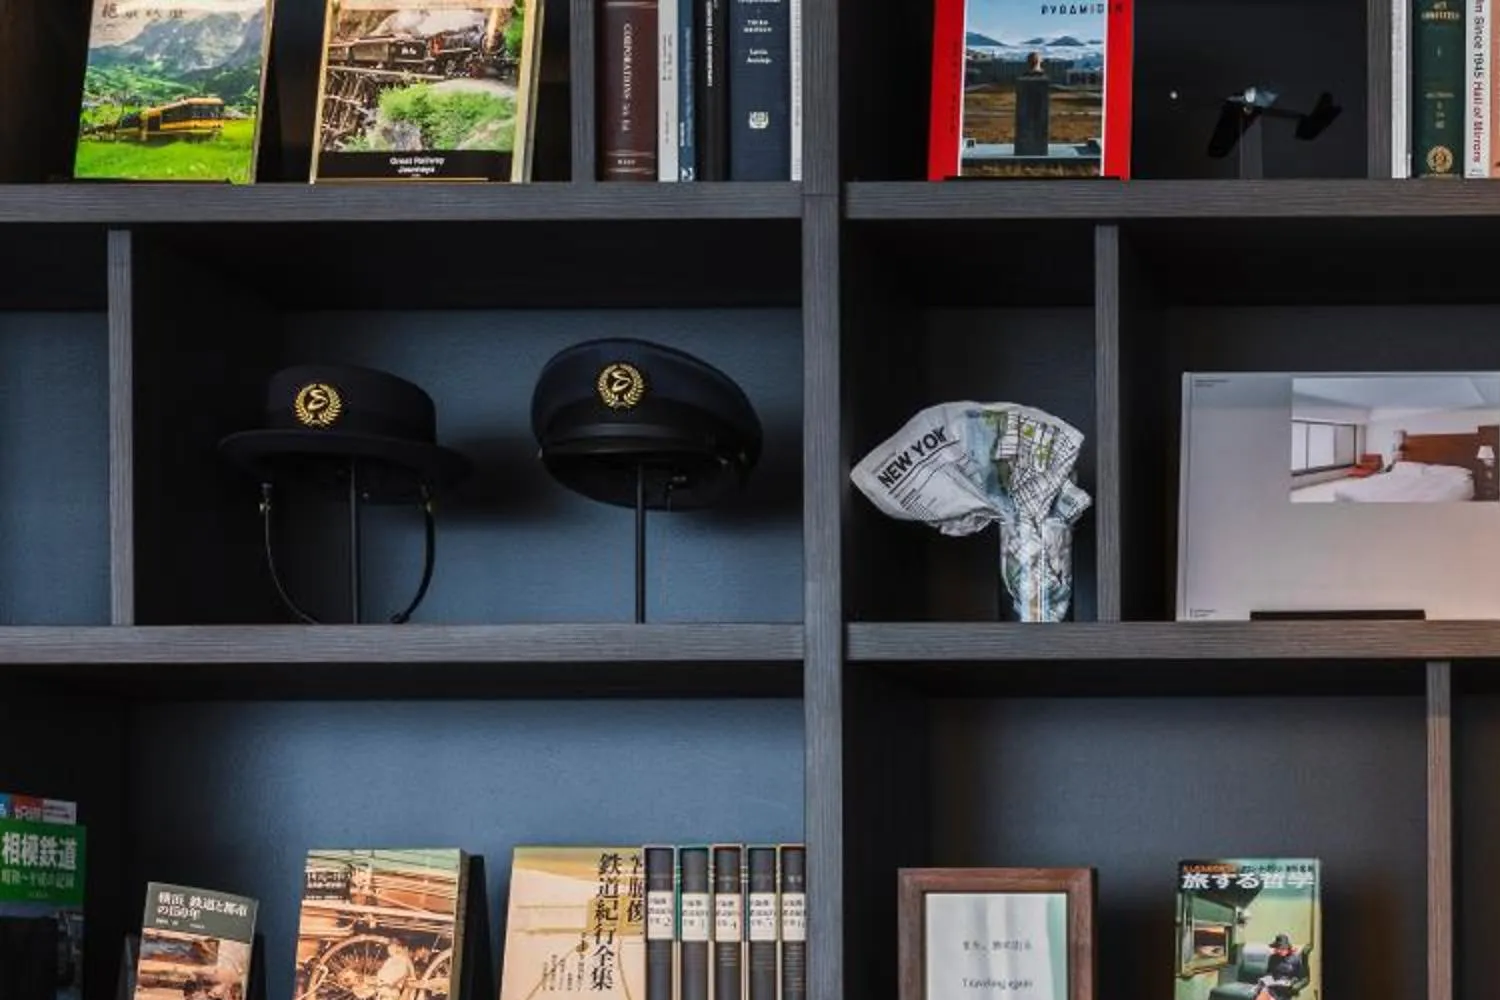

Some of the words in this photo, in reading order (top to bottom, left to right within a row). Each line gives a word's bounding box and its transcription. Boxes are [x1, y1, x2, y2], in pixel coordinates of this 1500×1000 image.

[1473, 81, 1485, 105] Hall
[877, 451, 913, 488] NEW
[1, 831, 77, 870] 相模鉄道
[1182, 873, 1315, 889] 旅する哲学
[591, 853, 622, 991] 鉄道紀行全集
